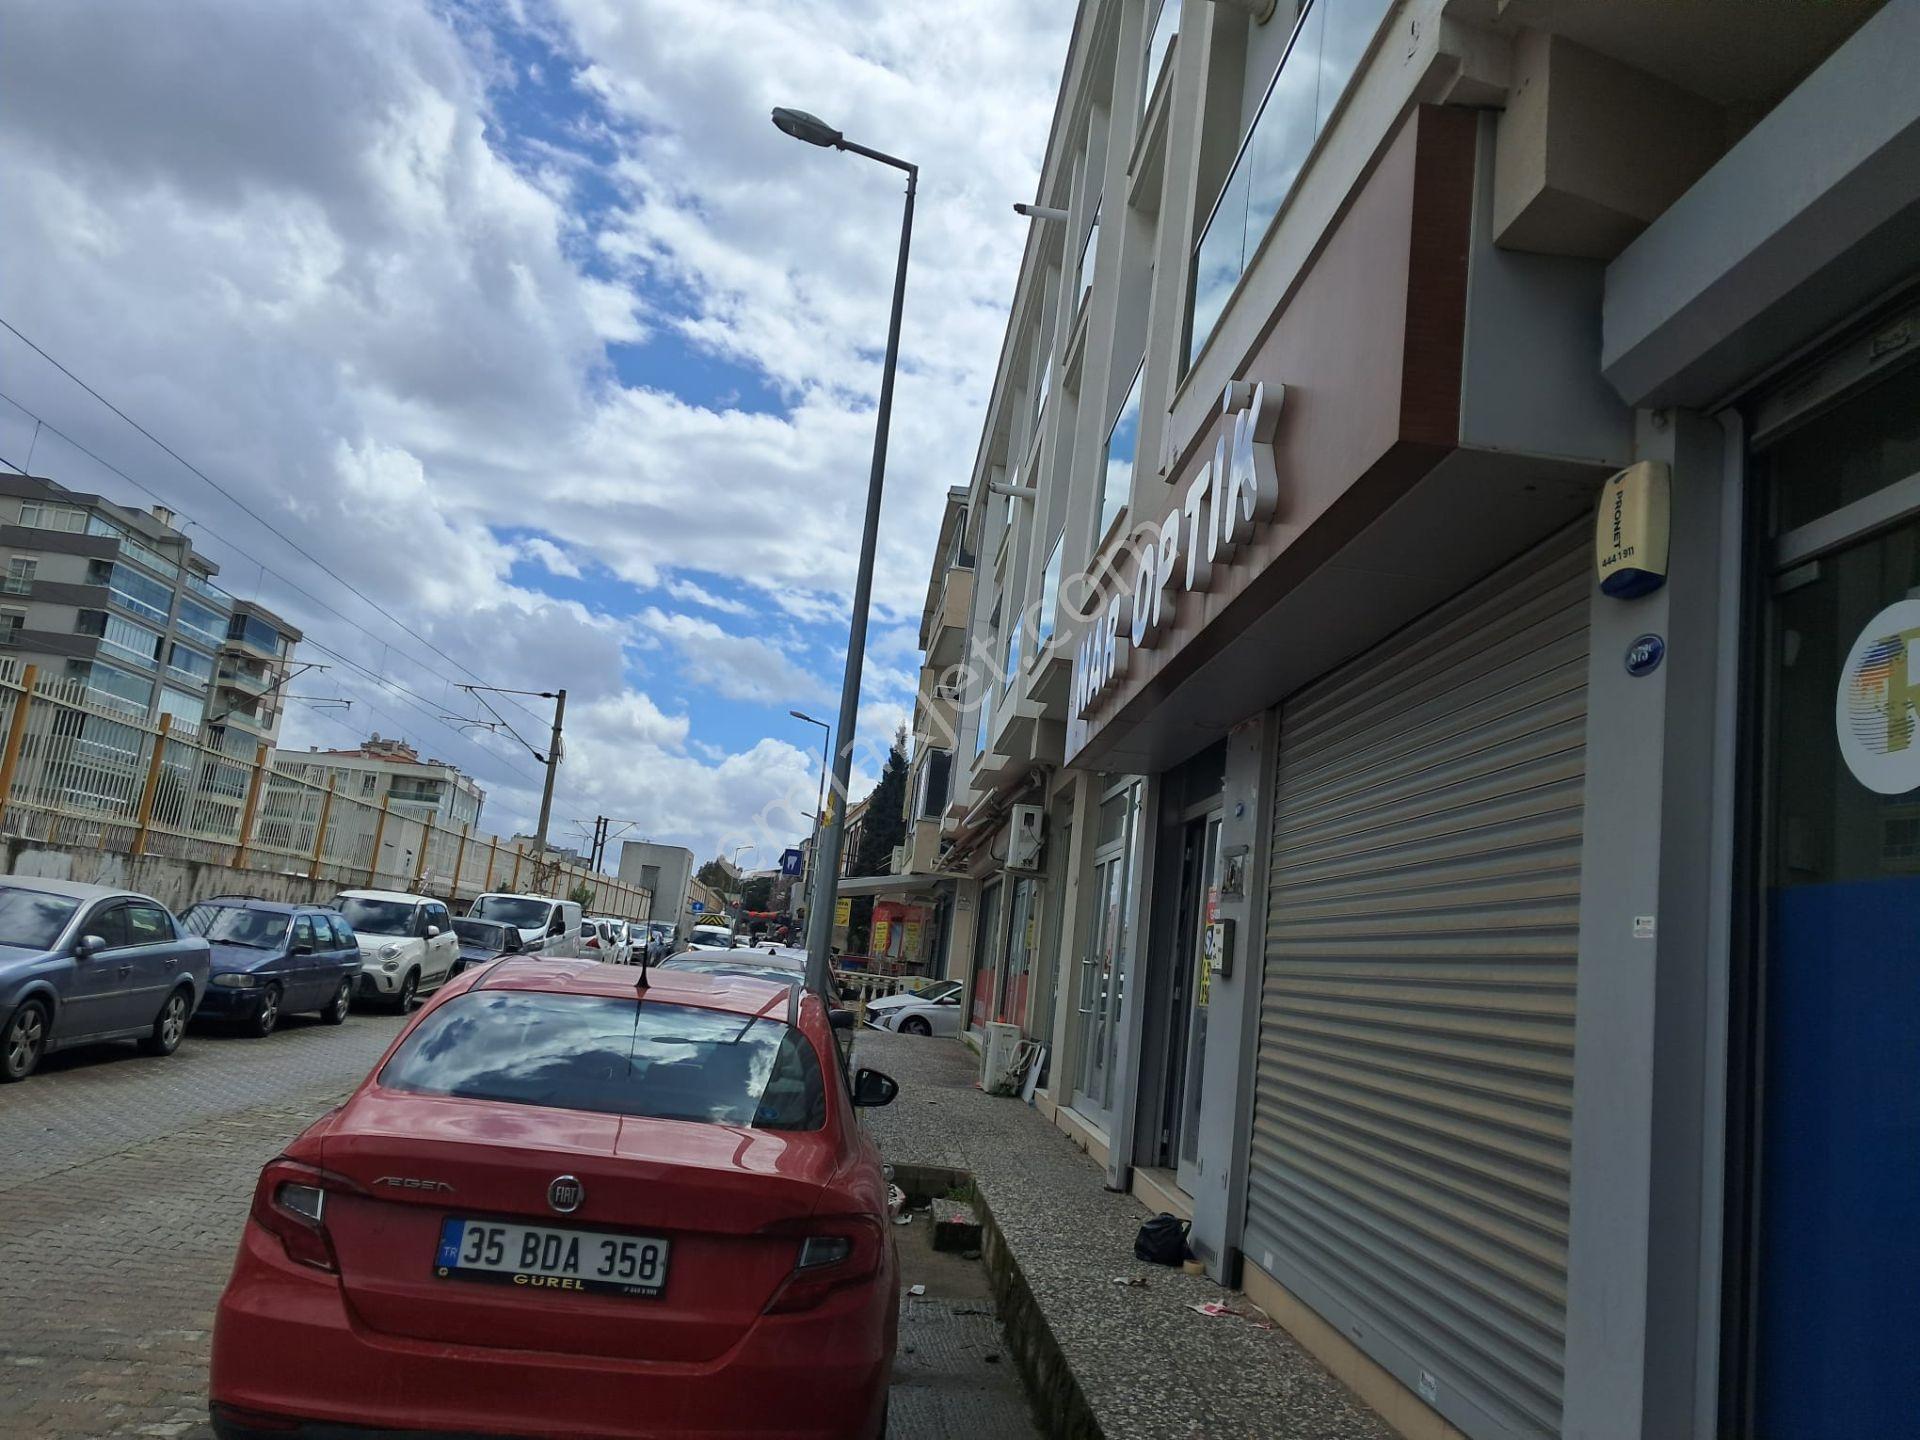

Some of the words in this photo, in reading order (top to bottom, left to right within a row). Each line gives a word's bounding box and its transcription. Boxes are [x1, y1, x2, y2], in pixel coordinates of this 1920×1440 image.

[1613, 490, 1624, 549] PRONET
[555, 1187, 576, 1204] FIAT
[443, 1247, 458, 1257] TR
[463, 1227, 505, 1265] 35
[519, 1231, 580, 1273] BDA
[596, 1240, 659, 1281] 358
[513, 1273, 585, 1291] GÜREL
